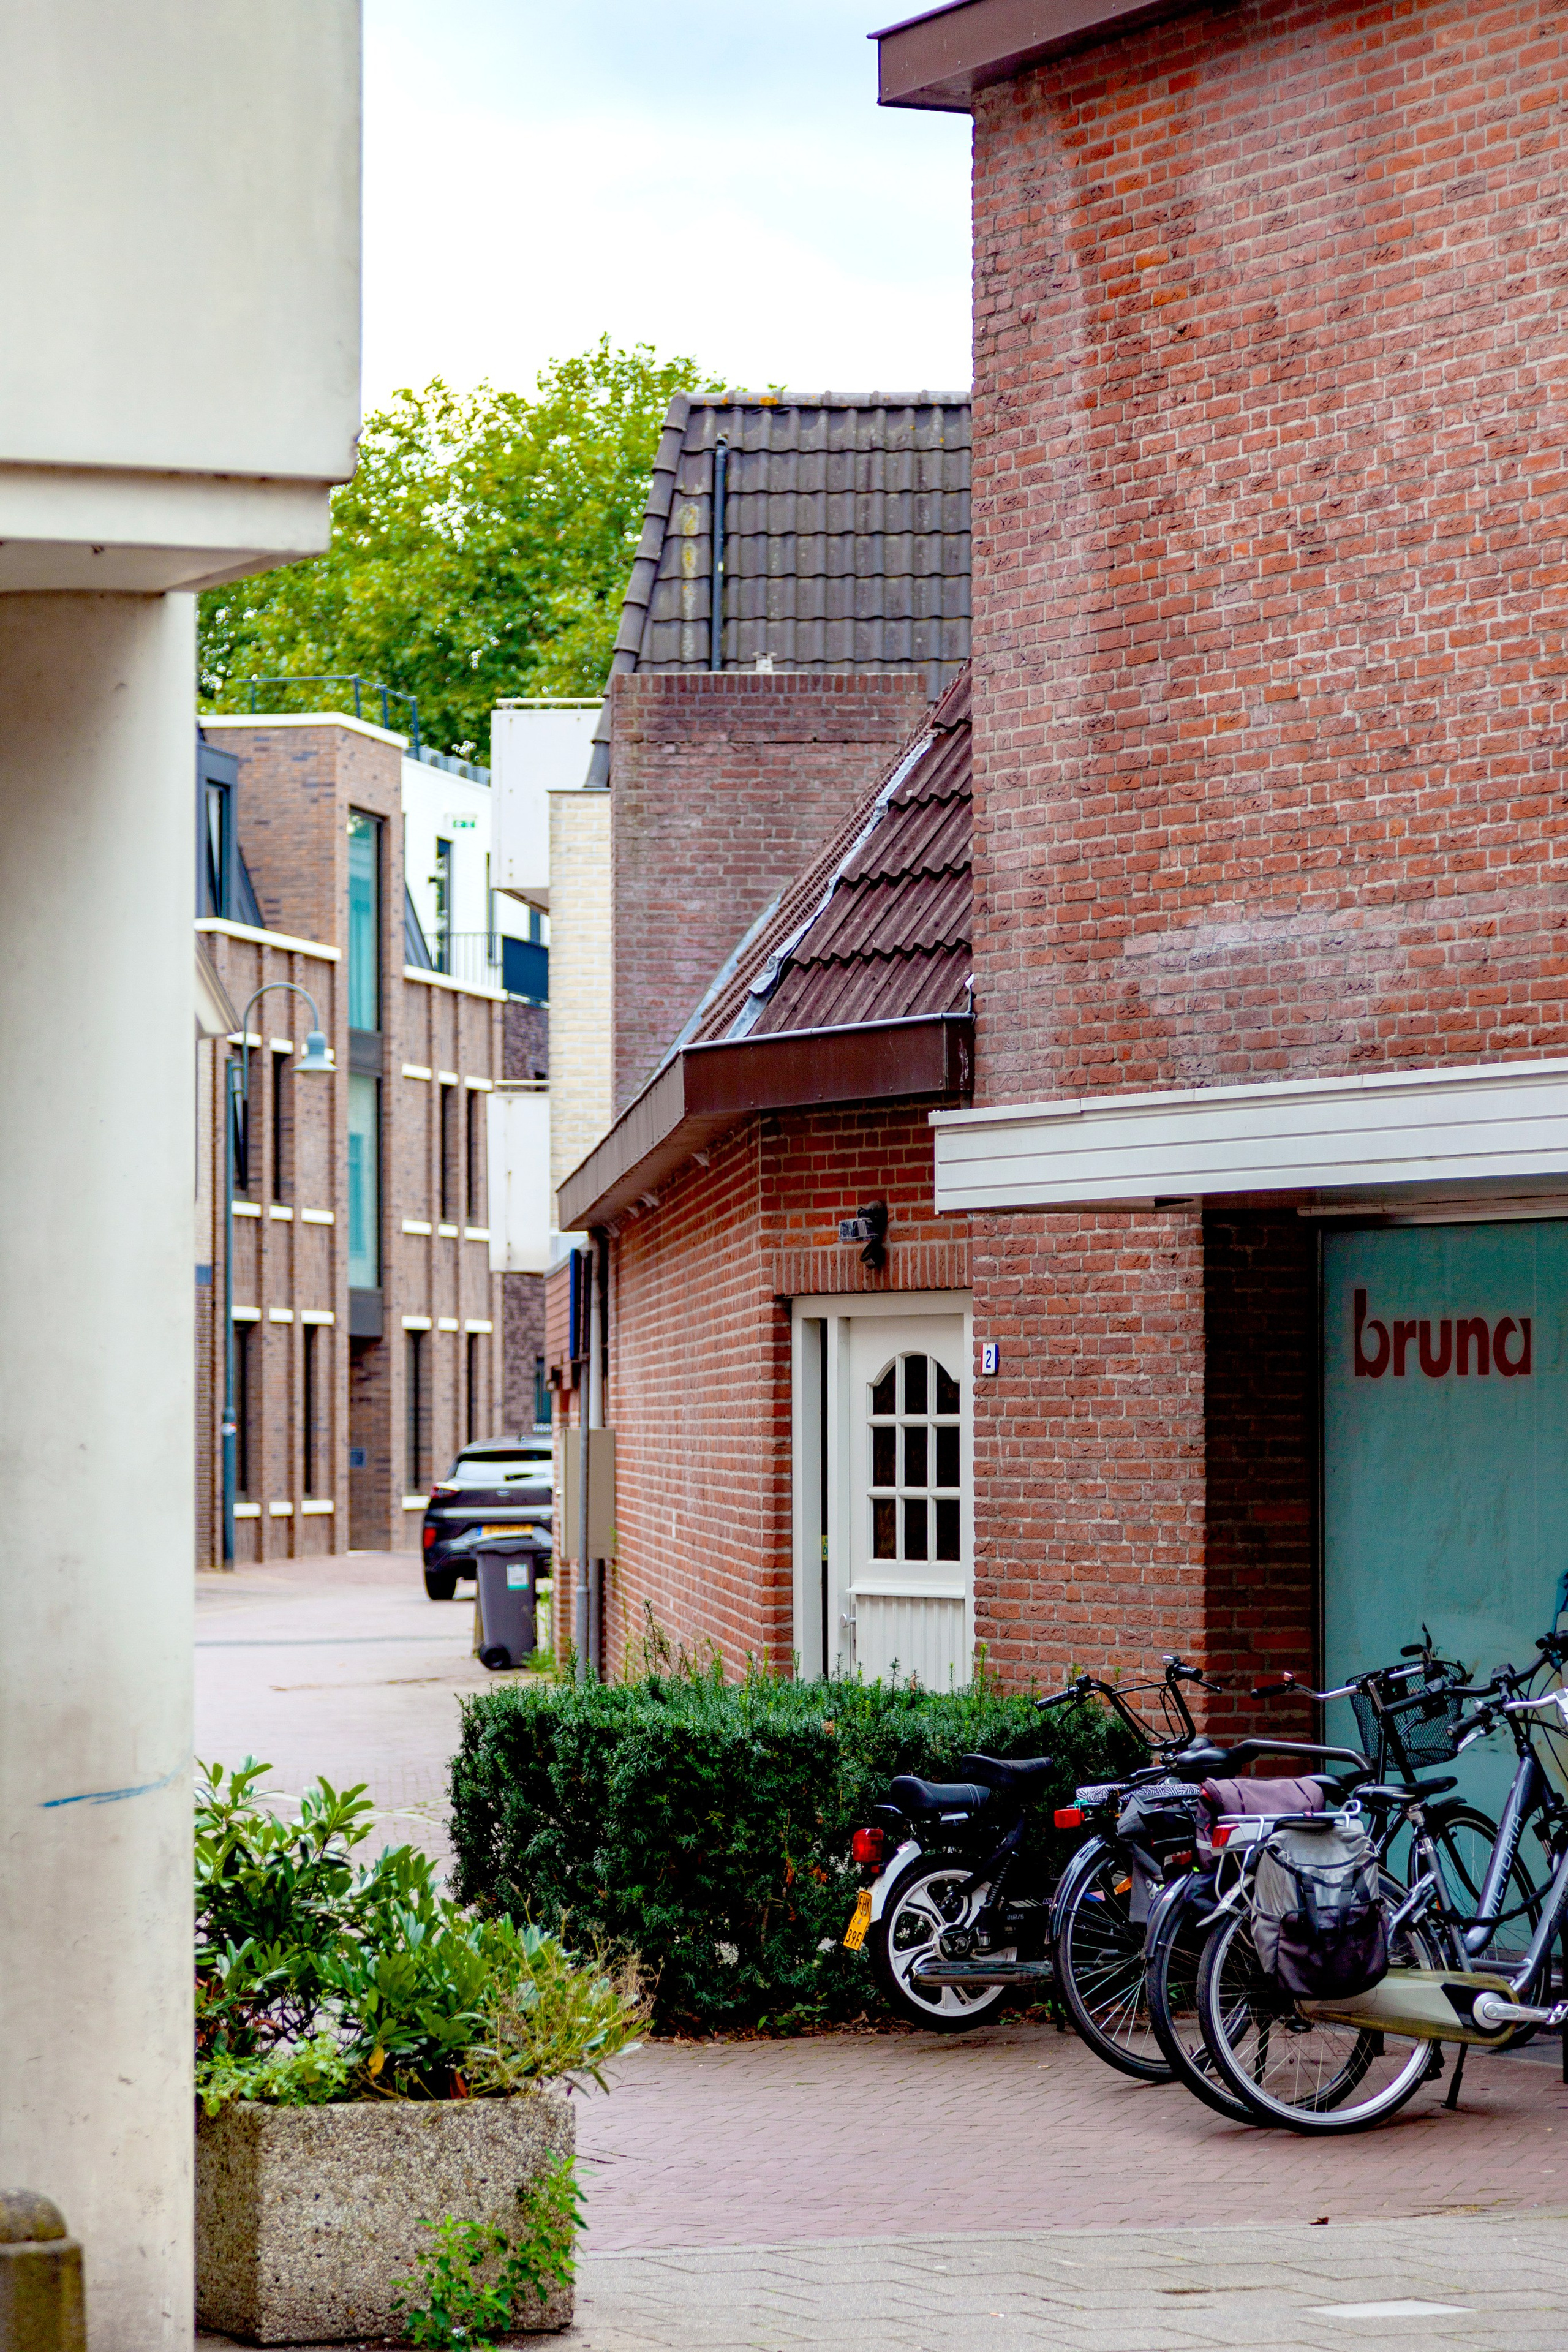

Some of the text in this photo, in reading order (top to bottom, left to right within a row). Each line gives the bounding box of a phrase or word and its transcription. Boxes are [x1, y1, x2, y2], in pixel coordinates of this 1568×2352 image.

[986, 1349, 992, 1368] 2
[1354, 1289, 1531, 1378] bruna
[1487, 1813, 1523, 1918] VICTORIA
[846, 1929, 862, 1946] 39F
